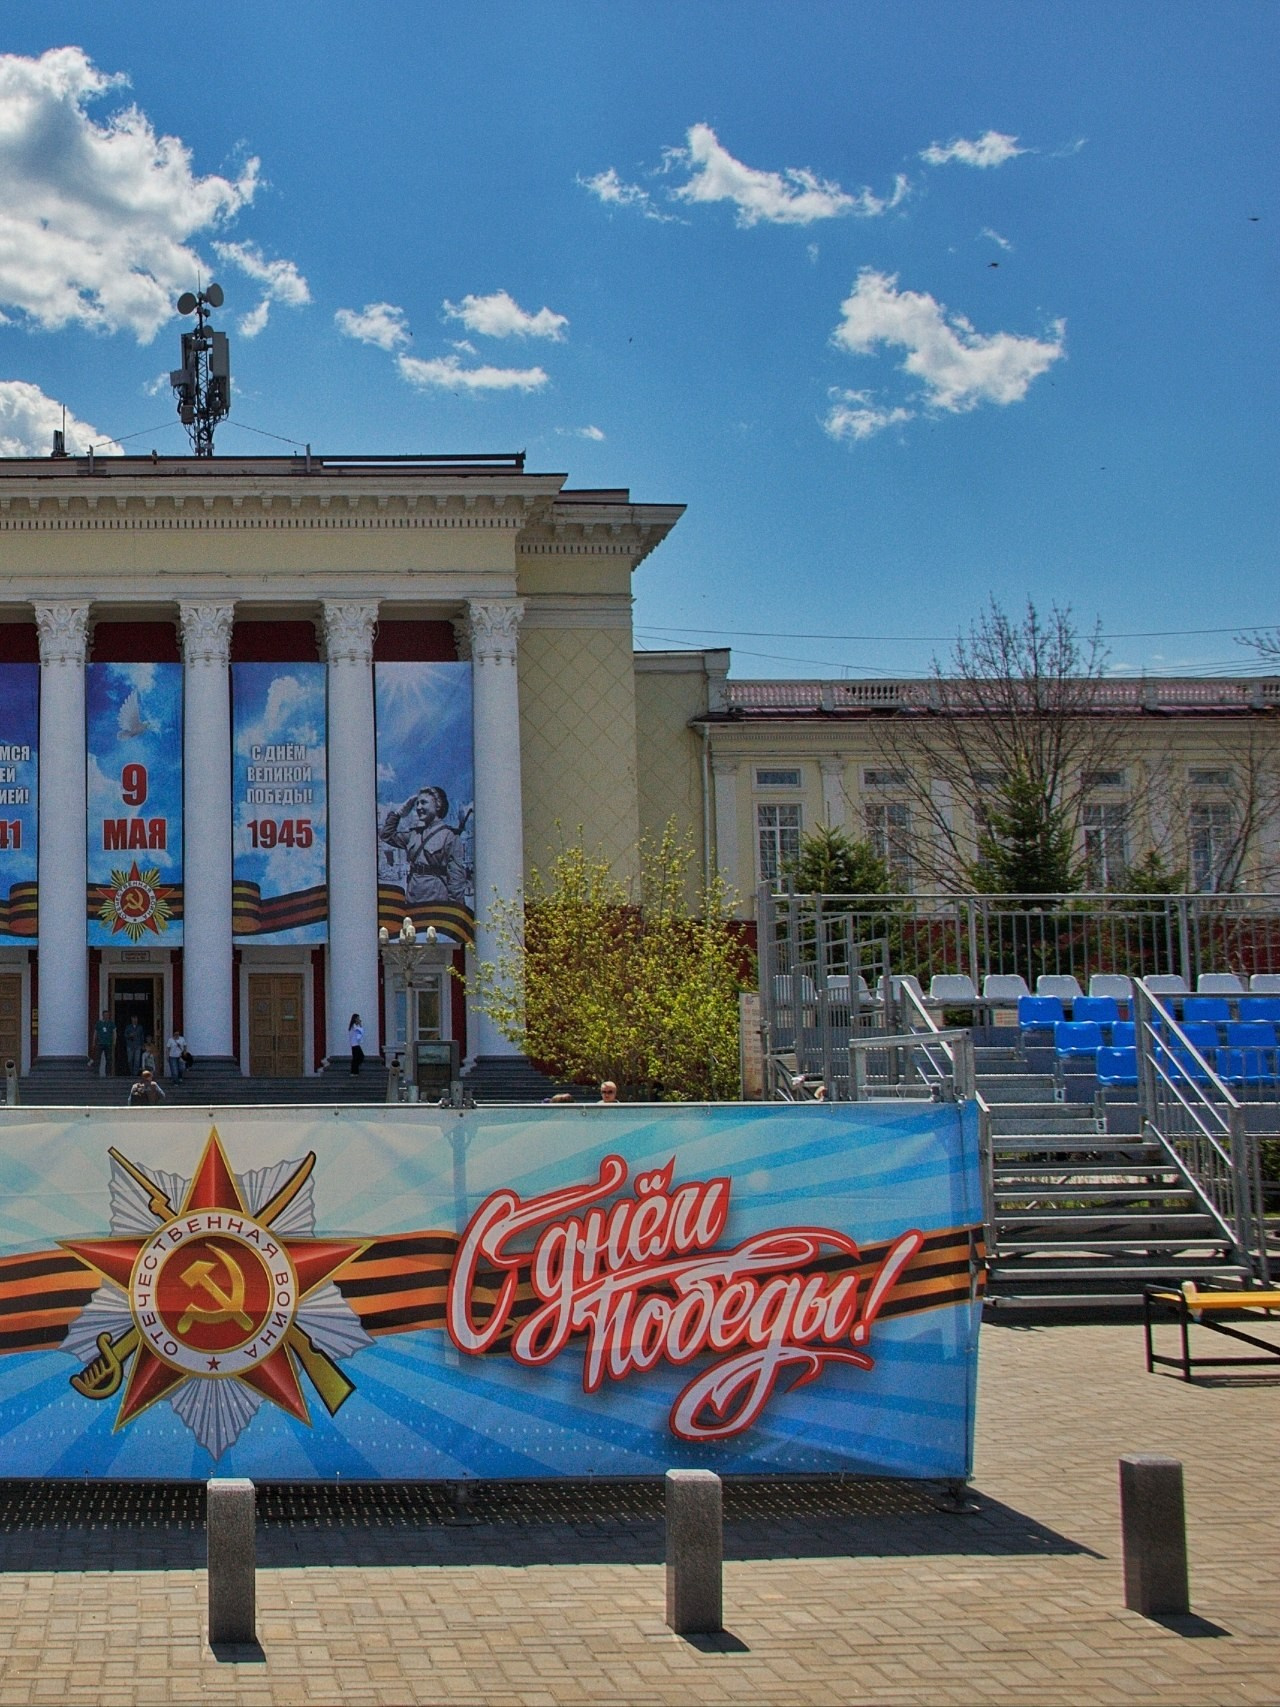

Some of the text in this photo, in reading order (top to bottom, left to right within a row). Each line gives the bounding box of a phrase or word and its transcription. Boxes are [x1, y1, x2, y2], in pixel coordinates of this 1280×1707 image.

[251, 743, 307, 763] С ДНЁМ
[121, 763, 148, 807] 9
[247, 764, 312, 782] ВЕЛИКОЙ
[246, 788, 313, 806] ПОБЕДЫ!
[103, 817, 167, 850] МАЯ
[246, 819, 314, 849] 1945
[447, 1154, 627, 1355] С
[138, 1216, 291, 1358] ОТЕЧЕСТВЕННАЯ ВОЙНА
[560, 1226, 925, 1441] Победы!
